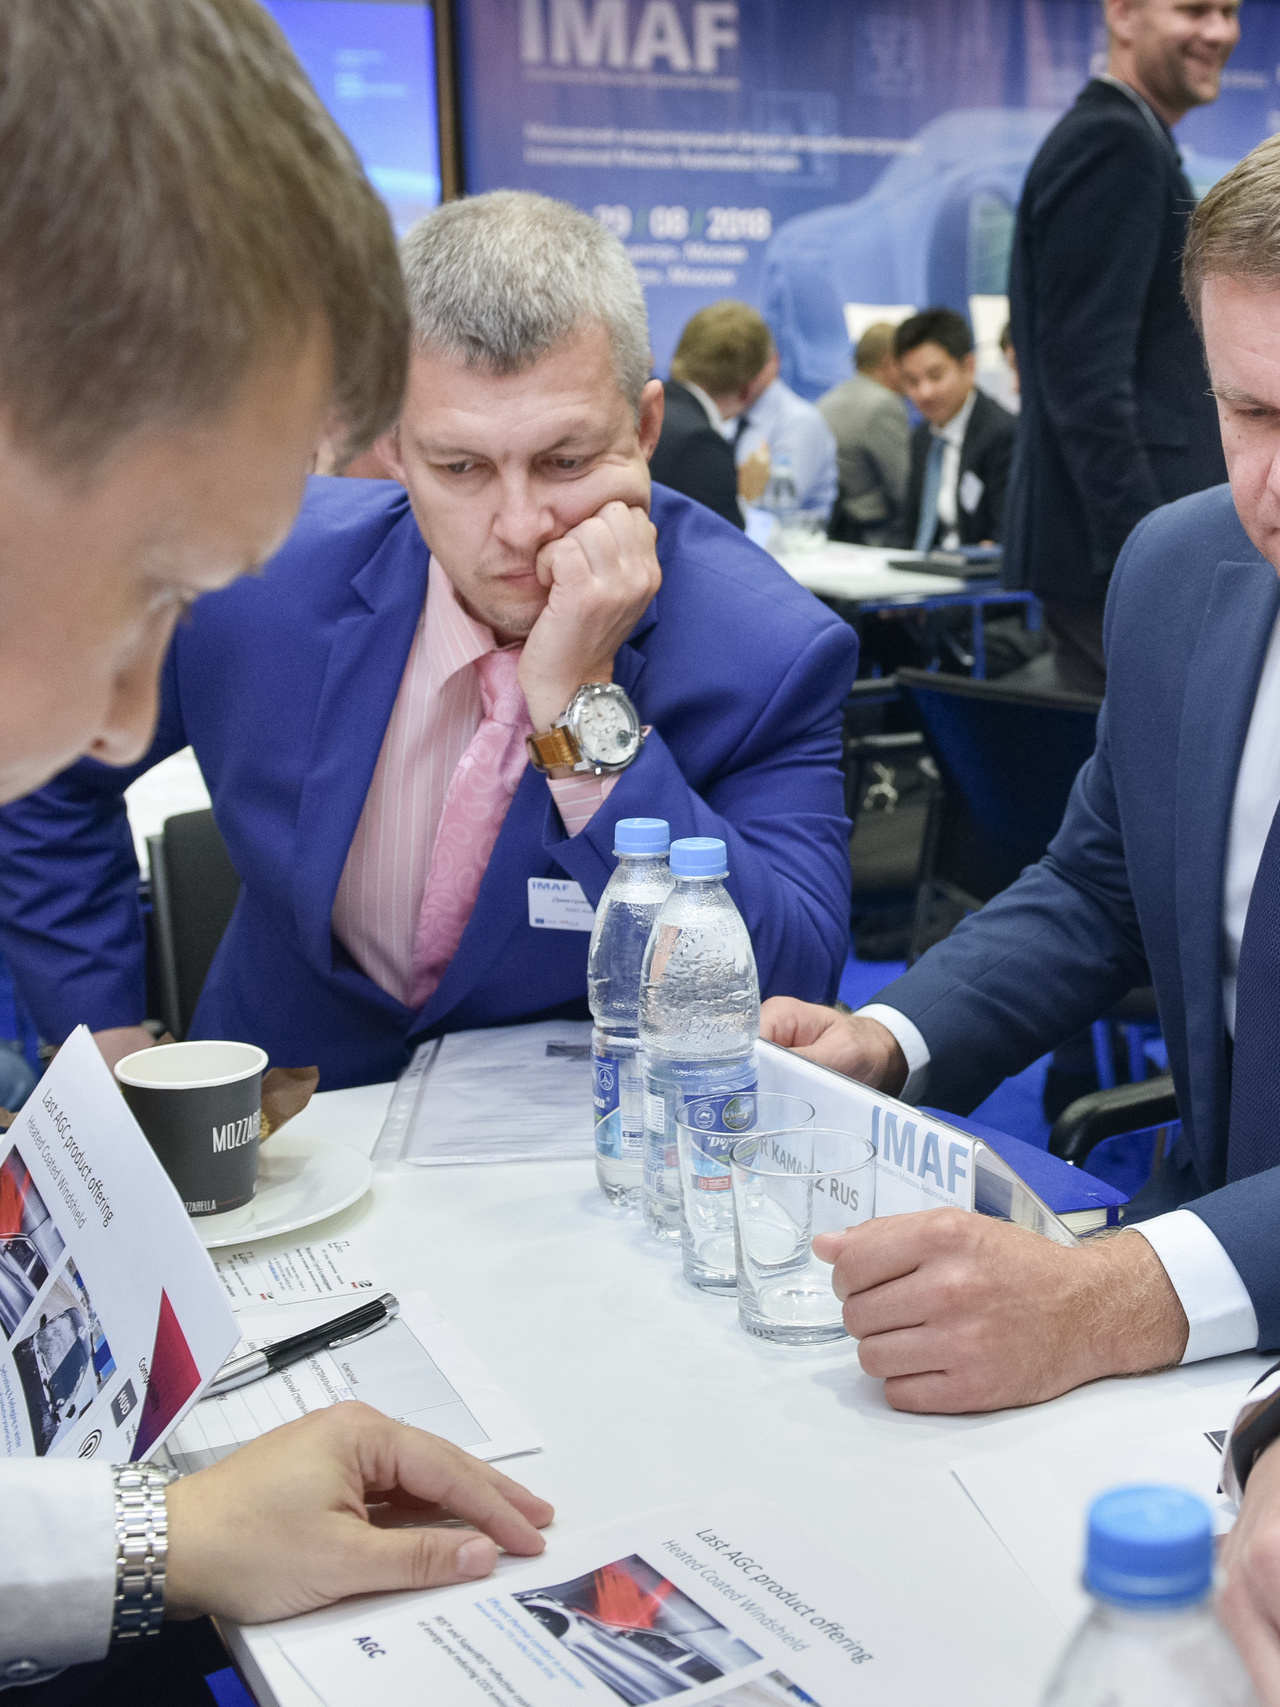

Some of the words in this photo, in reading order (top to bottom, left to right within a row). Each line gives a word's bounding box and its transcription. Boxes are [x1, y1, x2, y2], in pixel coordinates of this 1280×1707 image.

[521, 0, 739, 71] IMAF
[532, 882, 569, 891] IMAF
[26, 1115, 46, 1150] Heated
[41, 1145, 61, 1181] Coated
[57, 1173, 88, 1229] Windshield
[42, 1088, 58, 1118] Last
[52, 1110, 71, 1139] AGC
[62, 1136, 92, 1182] product
[87, 1176, 114, 1228] offering
[871, 1105, 970, 1194] IMAF
[829, 1177, 859, 1211] RUS
[341, 1362, 359, 1385] Компания
[117, 1390, 131, 1416] HUD
[661, 1539, 707, 1571] Heated
[699, 1568, 747, 1602] Coated
[739, 1599, 811, 1653] Windshield
[695, 1528, 730, 1551] Last
[721, 1551, 763, 1575] AGC
[748, 1573, 816, 1618] product
[809, 1616, 874, 1665] offering
[352, 1635, 386, 1659] AGC
[446, 1628, 462, 1639] and
